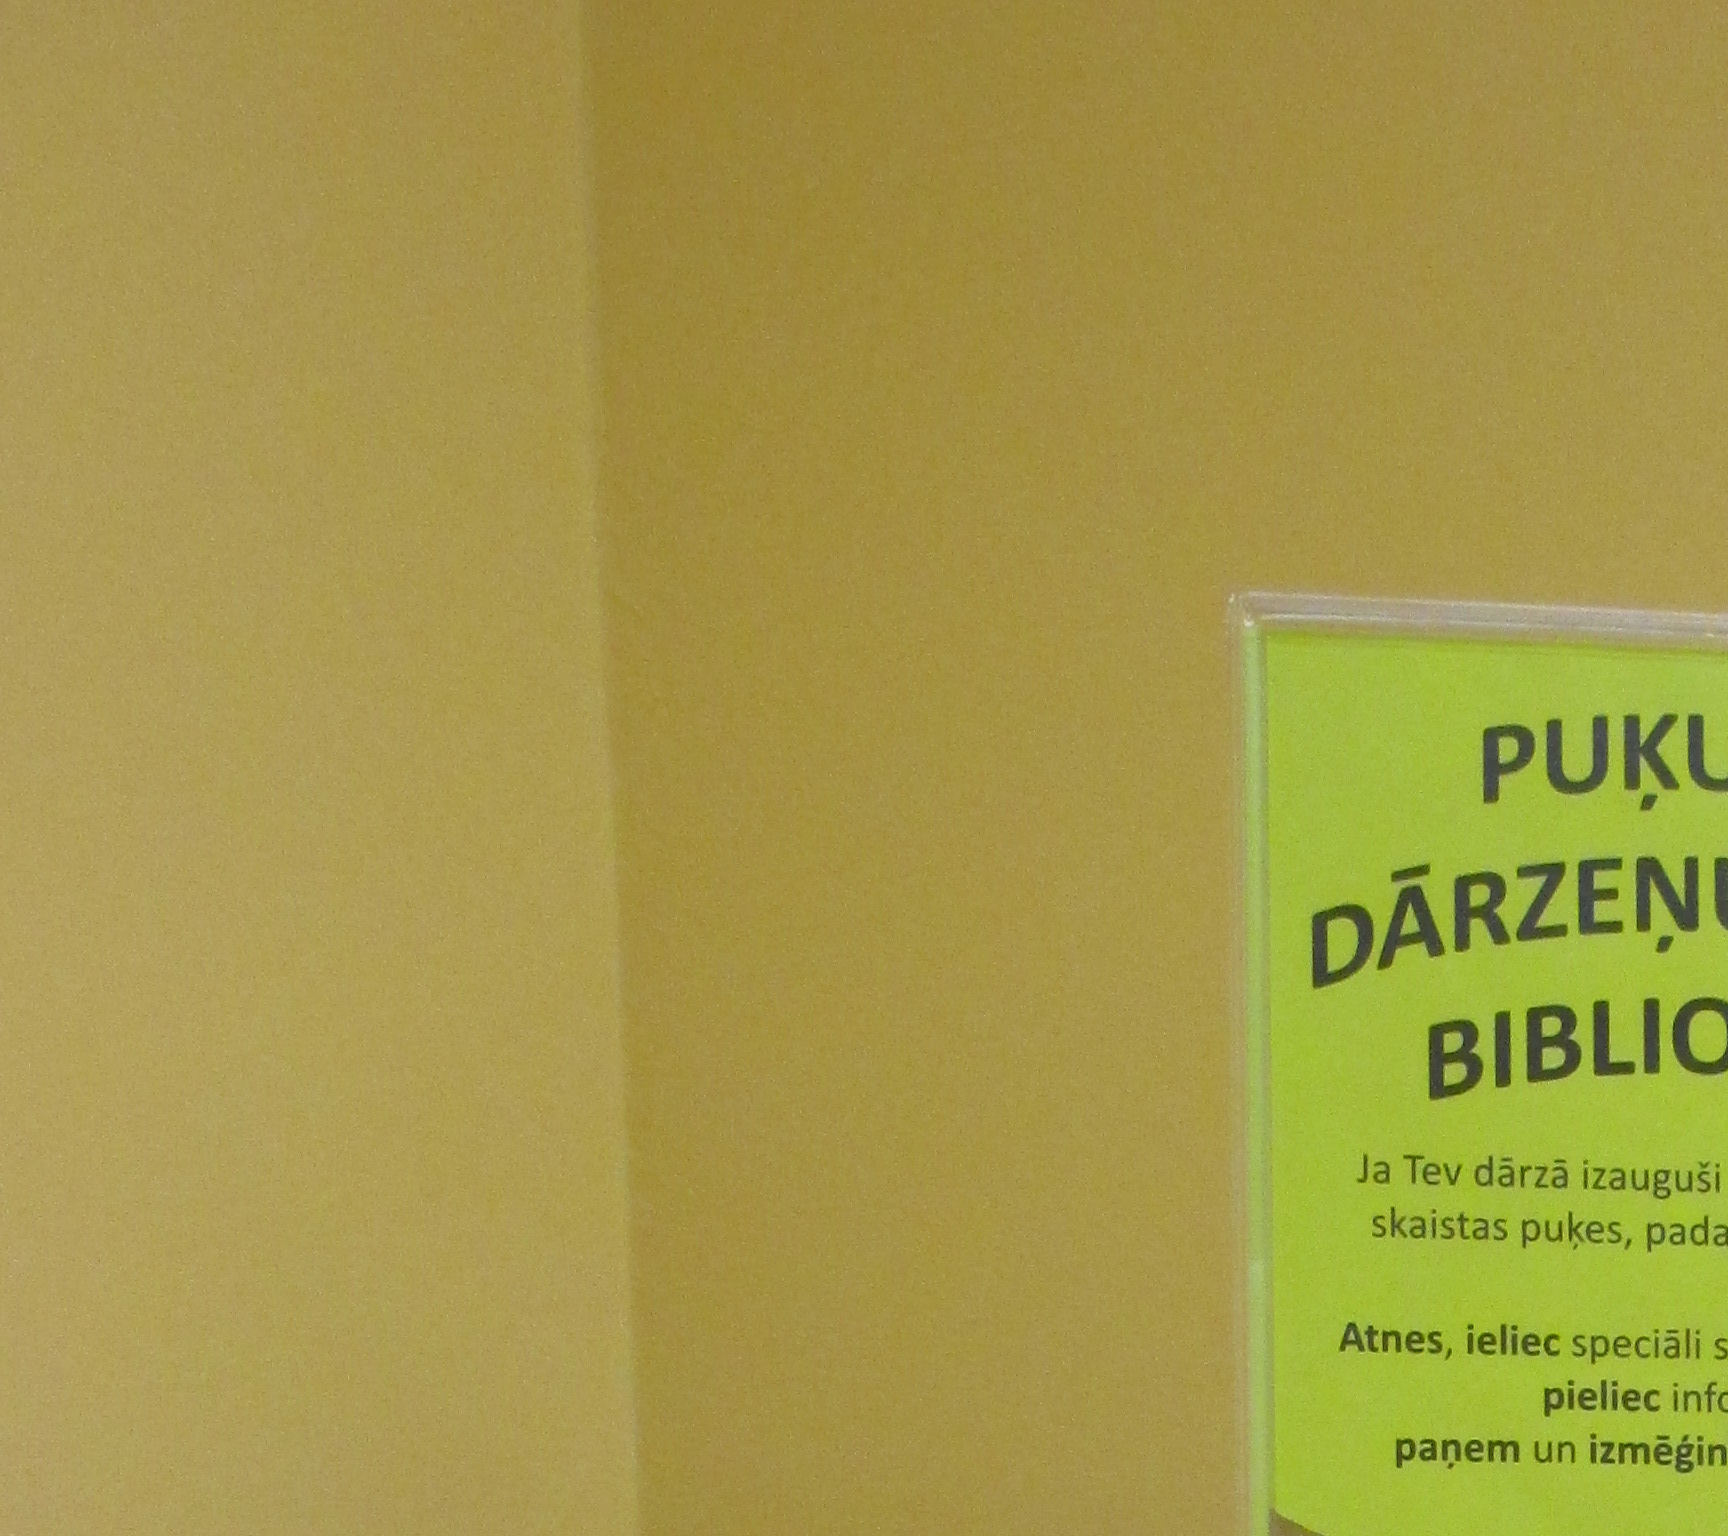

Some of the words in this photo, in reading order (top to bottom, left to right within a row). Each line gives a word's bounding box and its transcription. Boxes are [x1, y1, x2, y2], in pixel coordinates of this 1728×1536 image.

[1356, 1153, 1391, 1185] Ja
[1402, 1154, 1463, 1186] Tev
[1473, 1155, 1569, 1190] dārzā
[1582, 1159, 1721, 1200] izauguši
[1371, 1206, 1508, 1242] skaistas
[1521, 1210, 1632, 1250] puķes,
[1338, 1321, 1453, 1361] Atnes,
[1466, 1323, 1561, 1357] ieliec
[1571, 1327, 1701, 1365] speciāli
[1543, 1379, 1661, 1418] pieliec
[1395, 1437, 1521, 1470] paņem
[1533, 1440, 1576, 1464] un
